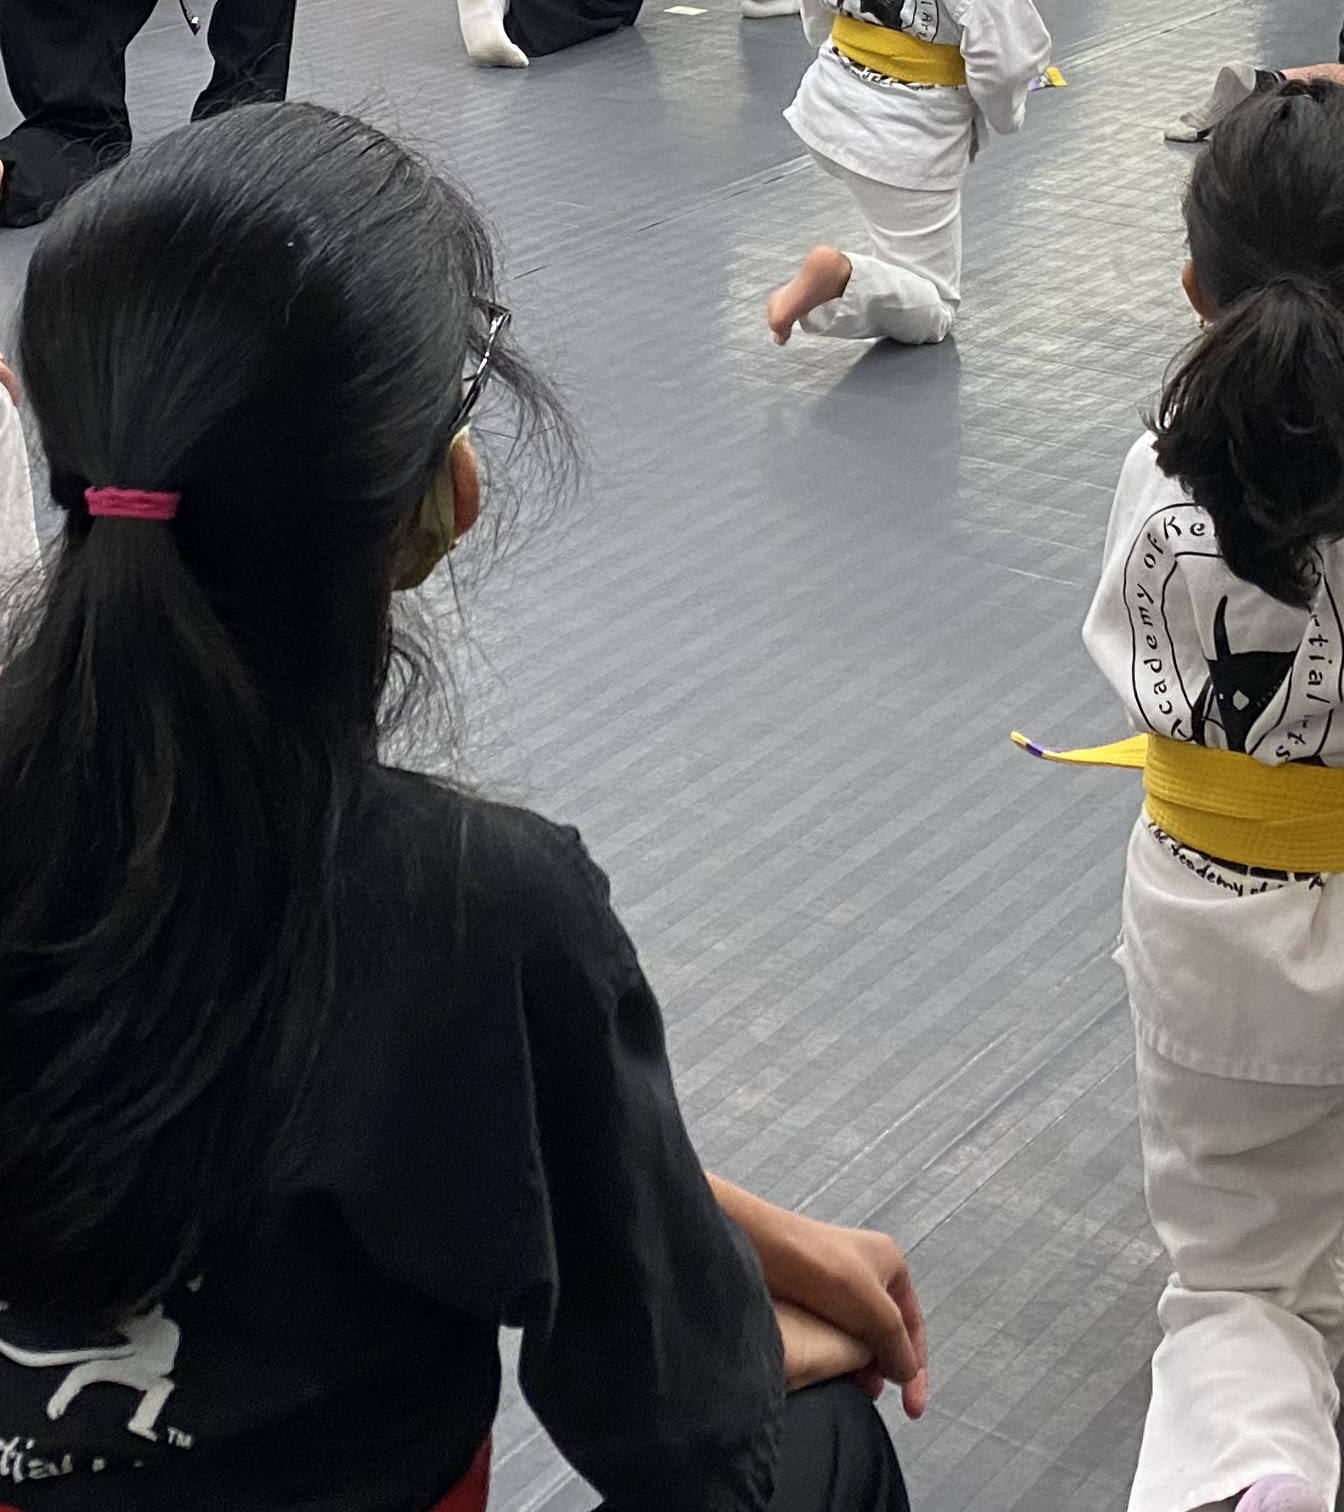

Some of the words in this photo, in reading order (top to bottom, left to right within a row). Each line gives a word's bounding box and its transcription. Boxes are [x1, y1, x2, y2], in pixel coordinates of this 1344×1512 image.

[918, 11, 934, 38] Art
[1143, 532, 1164, 569] of
[1136, 582, 1194, 739] Academy
[166, 1425, 193, 1449] TM
